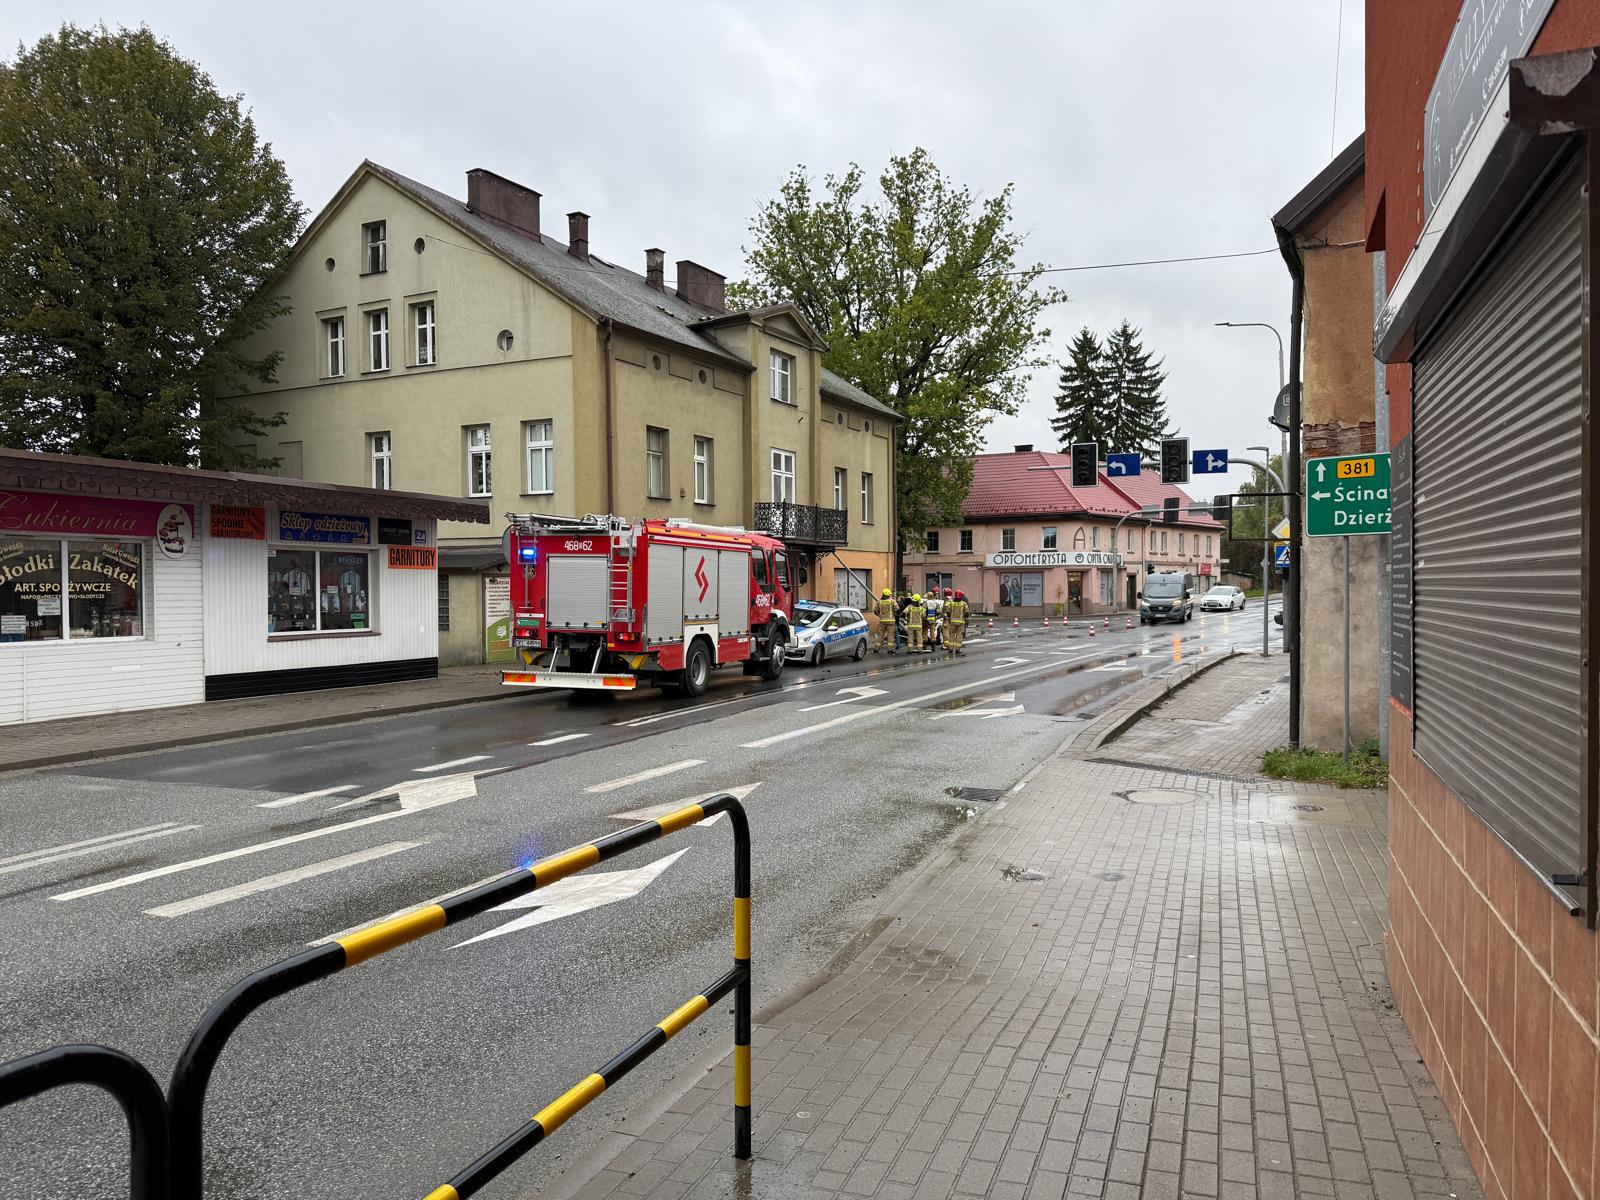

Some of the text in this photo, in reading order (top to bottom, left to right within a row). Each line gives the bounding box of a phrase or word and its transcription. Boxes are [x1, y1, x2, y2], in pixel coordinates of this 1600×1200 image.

[1344, 462, 1369, 475] 381
[1334, 482, 1391, 502] Ścina
[212, 517, 244, 529] SPODNIE
[281, 512, 312, 533] Sklep
[390, 548, 435, 566] GARNITURY
[993, 553, 1067, 565] OPTOMETRYSTA
[70, 554, 138, 589] Zakątek
[14, 583, 37, 592] ART.
